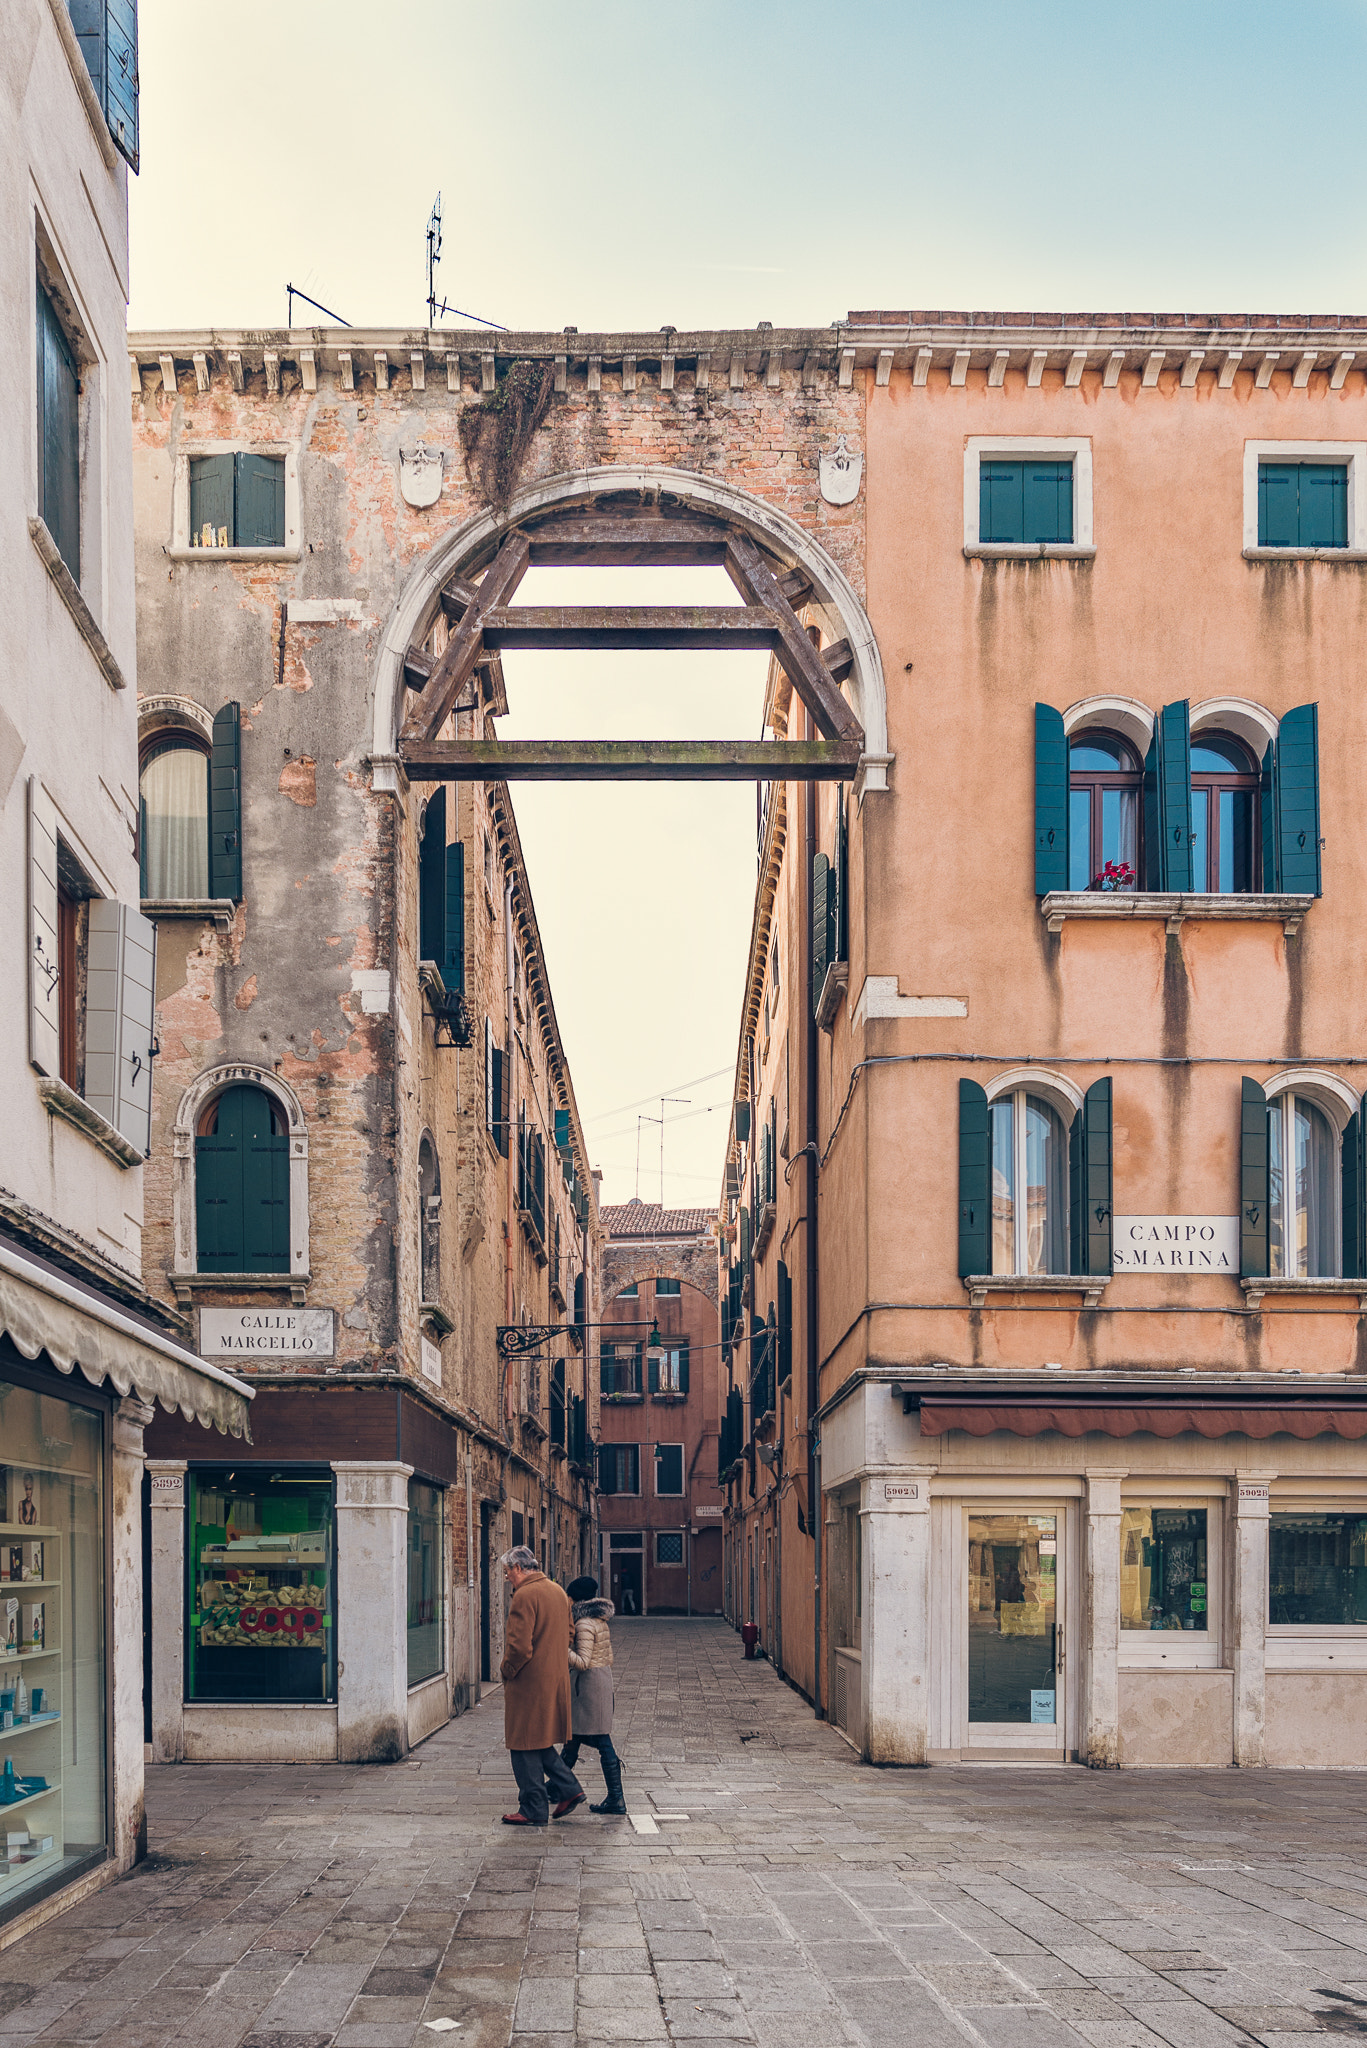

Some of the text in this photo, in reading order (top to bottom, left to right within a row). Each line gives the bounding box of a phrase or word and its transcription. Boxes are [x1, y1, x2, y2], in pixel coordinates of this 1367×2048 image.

[1129, 1225, 1215, 1241] CAMPO
[1113, 1249, 1230, 1266] S.MARINA
[240, 1316, 296, 1329] CALLE
[220, 1335, 314, 1350] MARCELLO
[152, 1479, 180, 1488] 5892
[1239, 1489, 1268, 1497] 5902B
